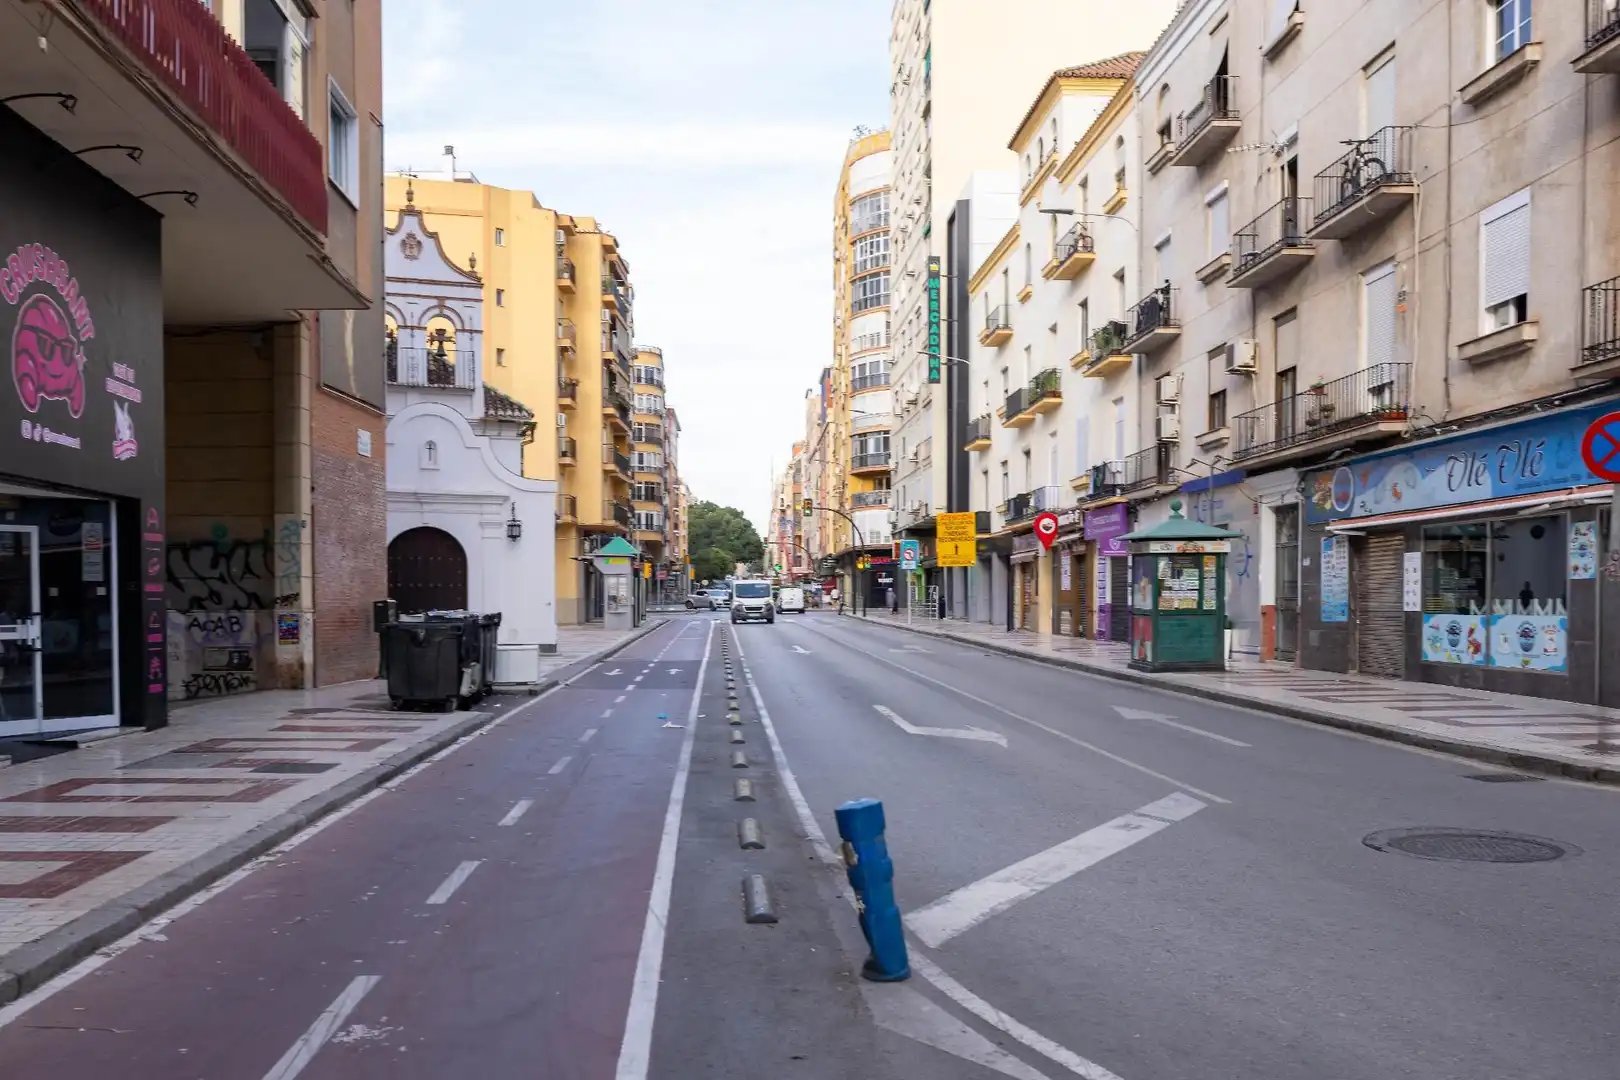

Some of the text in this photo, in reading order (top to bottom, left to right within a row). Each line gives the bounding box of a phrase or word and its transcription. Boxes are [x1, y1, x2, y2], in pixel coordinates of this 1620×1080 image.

[928, 278, 940, 380] MERCADONA
[1445, 439, 1545, 492] Olé Olé
[188, 616, 243, 633] ACAB
